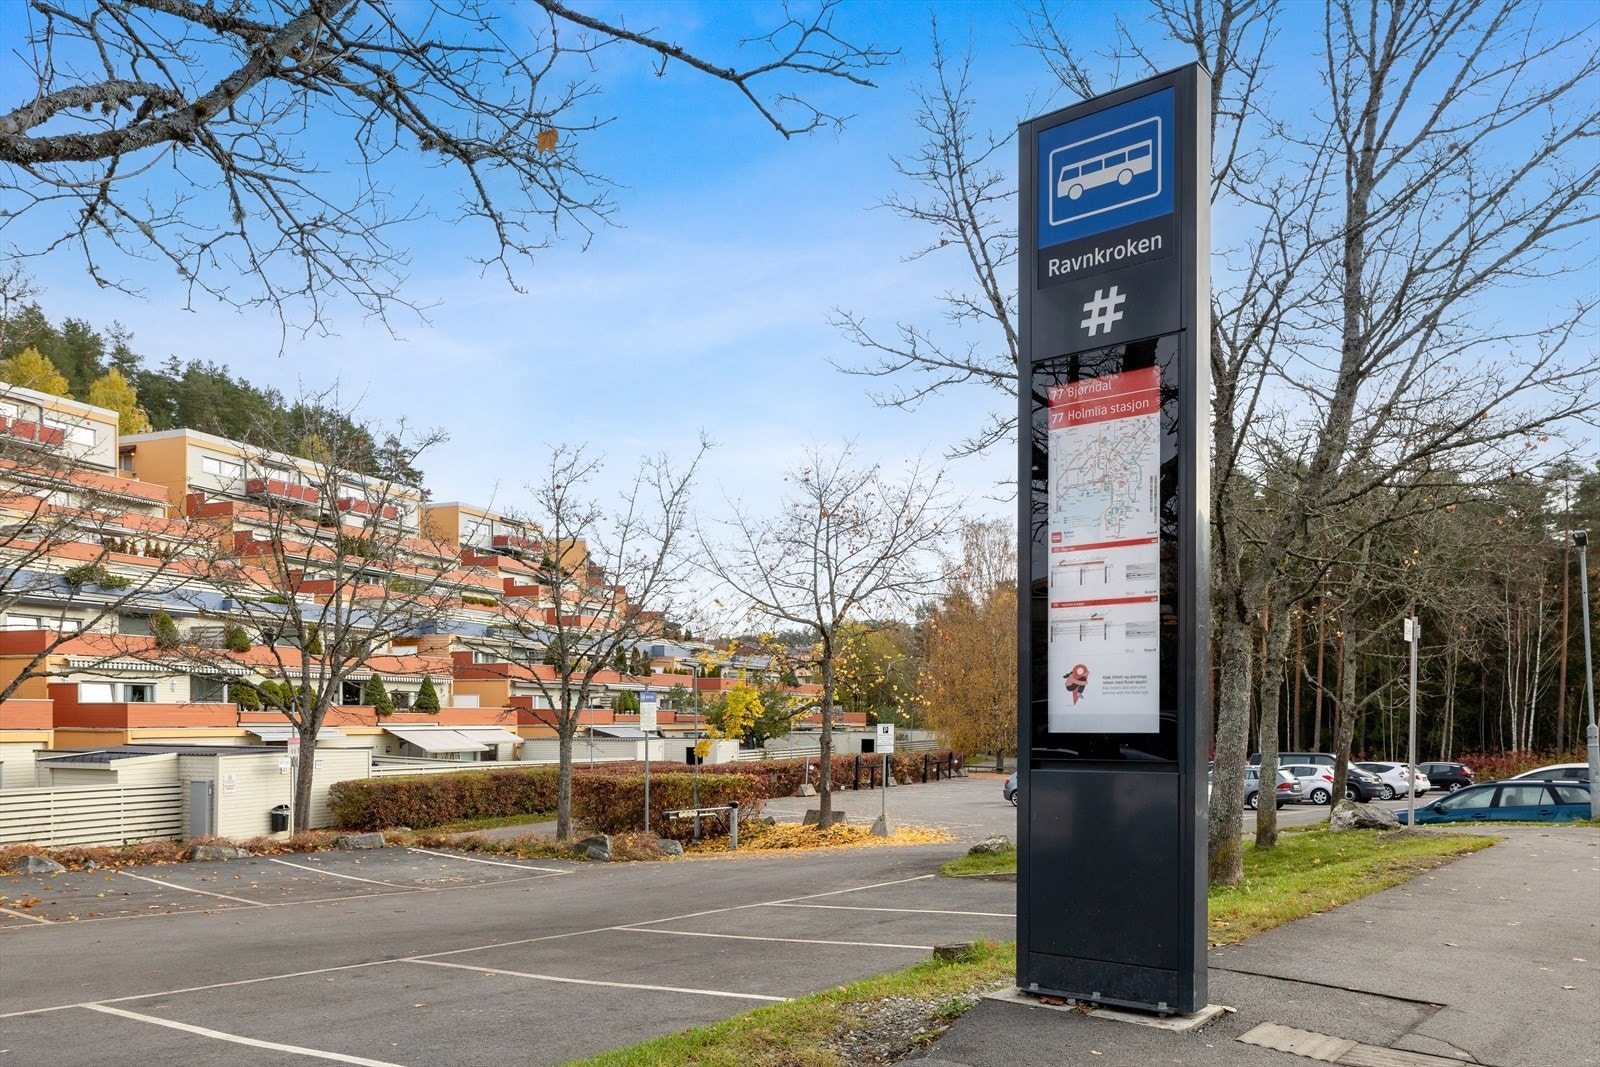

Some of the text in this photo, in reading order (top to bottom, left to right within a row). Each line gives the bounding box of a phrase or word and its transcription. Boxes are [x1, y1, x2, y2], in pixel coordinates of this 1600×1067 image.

[1048, 234, 1162, 278] Ravnkroken
[1050, 380, 1112, 401] 77 Bjørndal
[1051, 398, 1149, 425] 77 Holmlia stasjon
